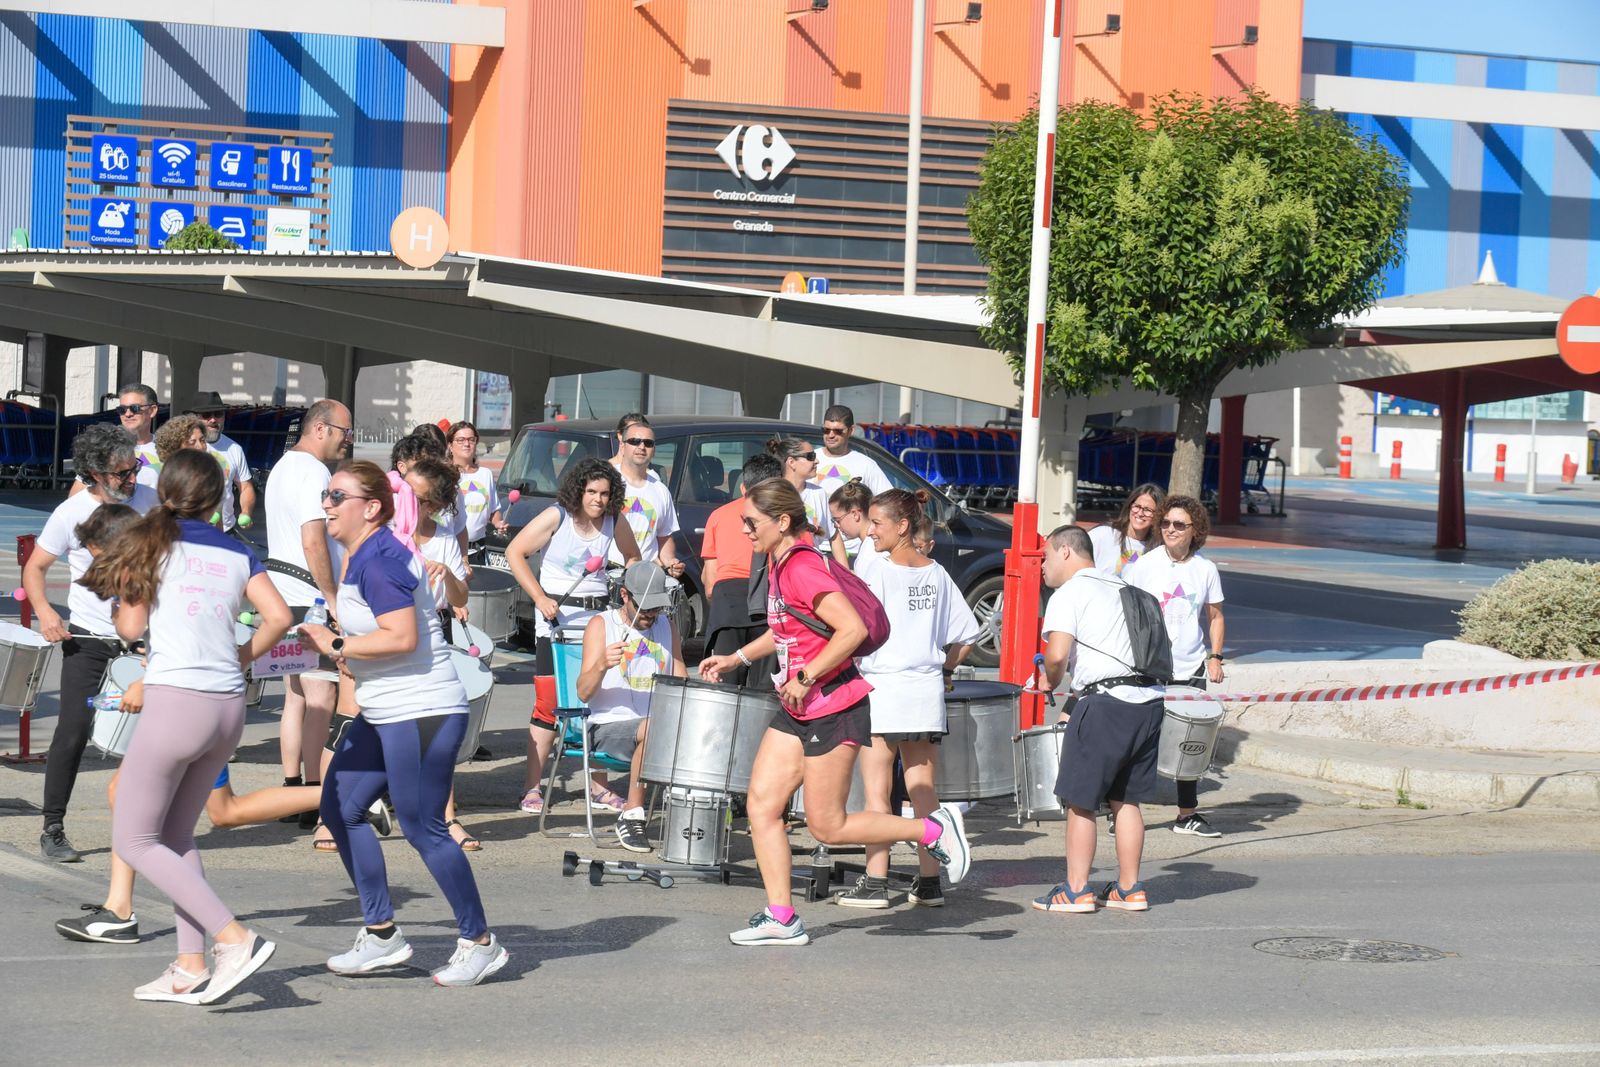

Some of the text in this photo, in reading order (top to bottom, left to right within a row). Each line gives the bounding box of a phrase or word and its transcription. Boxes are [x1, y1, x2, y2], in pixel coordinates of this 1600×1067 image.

[107, 173, 128, 181] tiendas
[161, 176, 186, 184] Gratuito
[217, 180, 247, 188] Gasolinera
[271, 183, 308, 192] Restauración
[713, 189, 796, 204] Centro Comercial
[733, 220, 774, 232] Granada
[91, 235, 134, 244] Complementos
[409, 222, 433, 252] H
[908, 584, 937, 597] BLOCO
[270, 643, 303, 659] 6849
[280, 662, 305, 672] vithas
